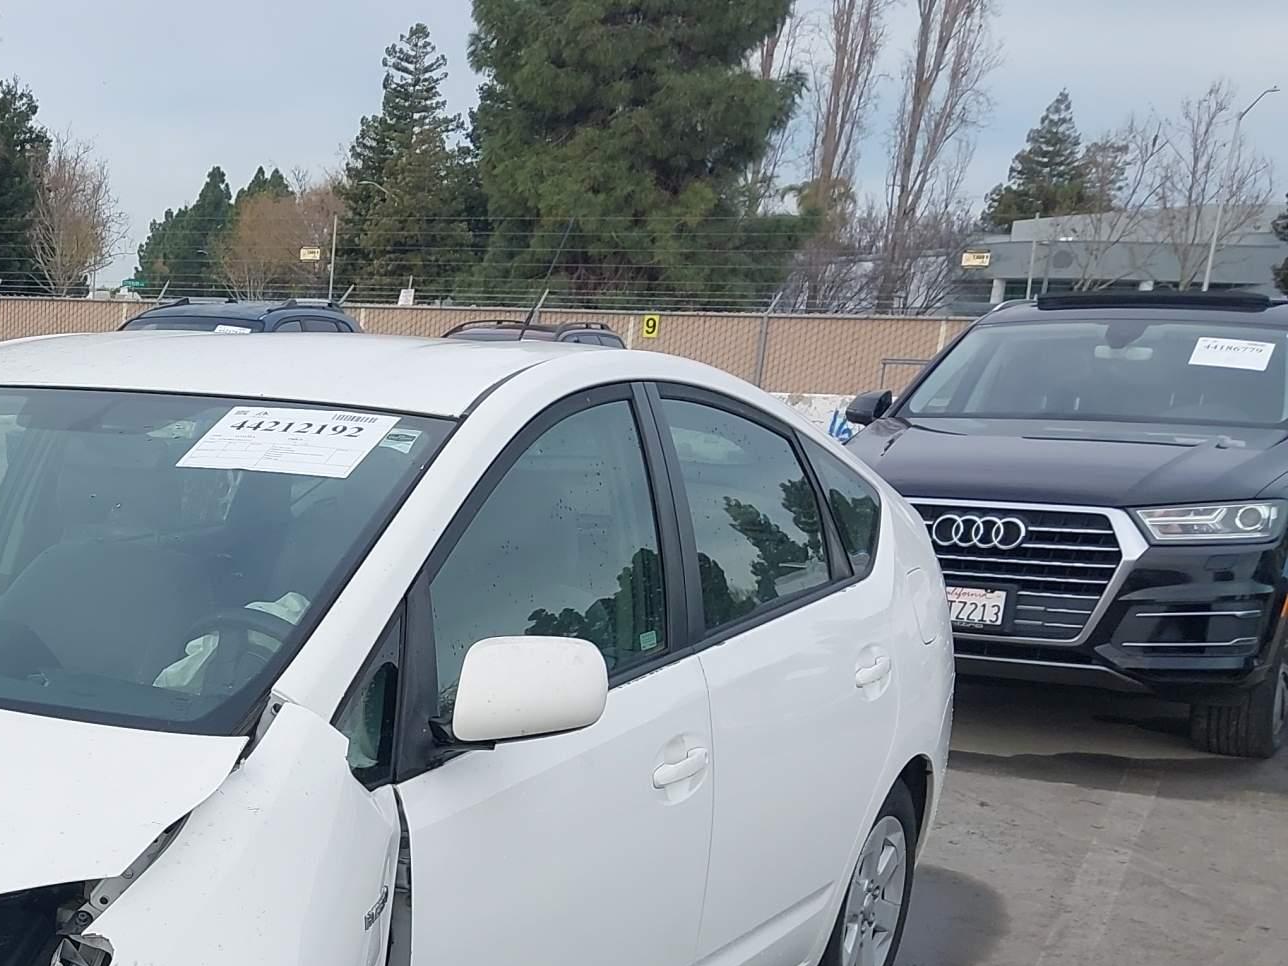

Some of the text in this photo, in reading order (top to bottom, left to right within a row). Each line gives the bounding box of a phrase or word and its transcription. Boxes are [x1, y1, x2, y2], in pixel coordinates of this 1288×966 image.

[645, 317, 657, 335] 9
[230, 419, 364, 438] 44212192
[947, 600, 1001, 624] TZ213
